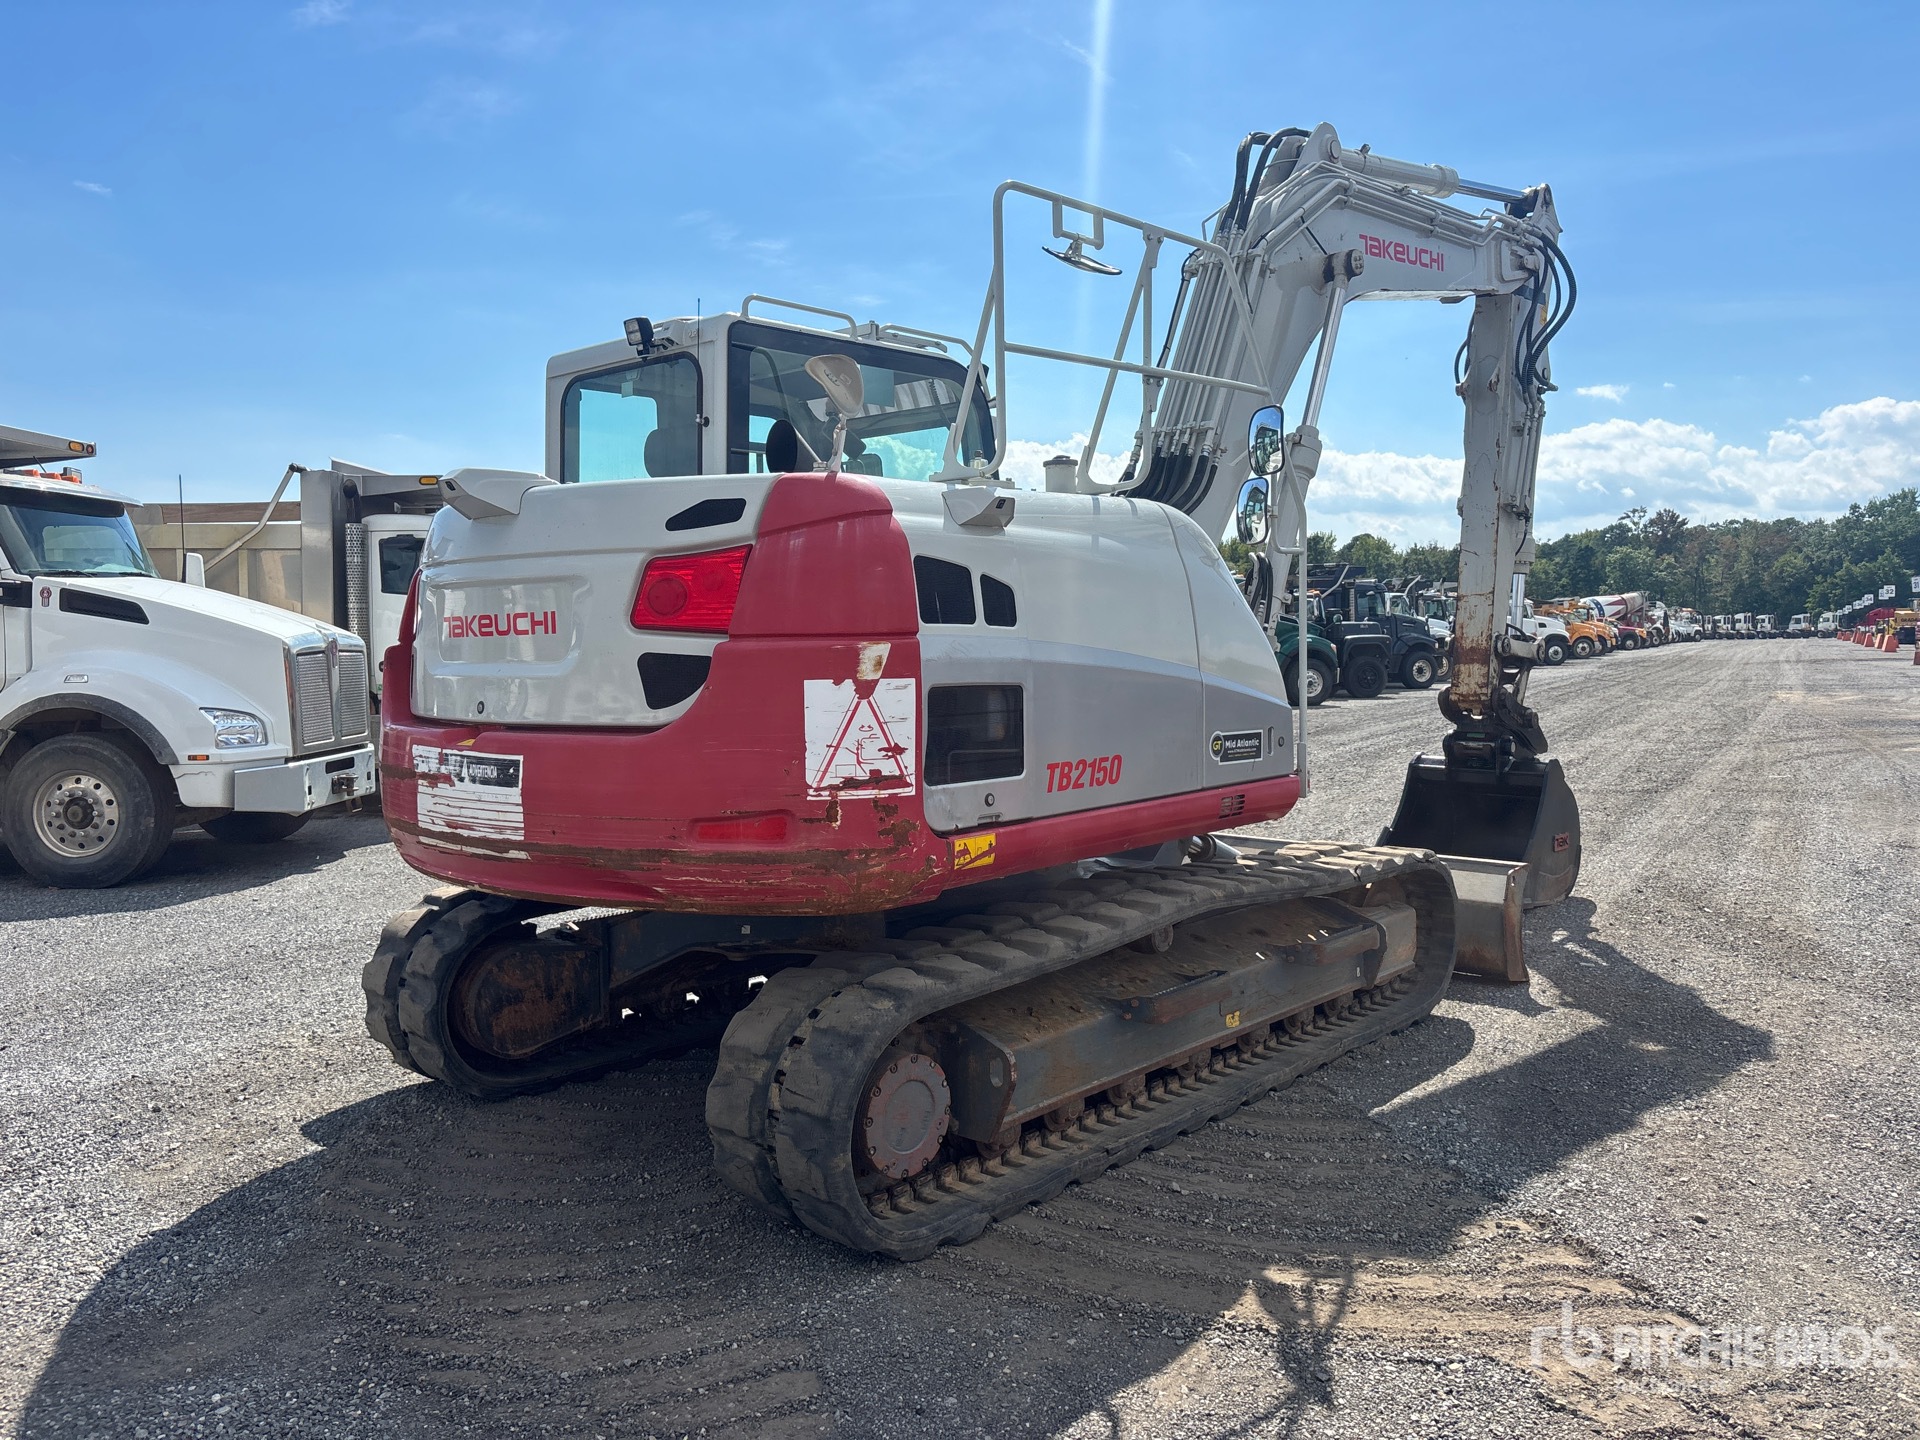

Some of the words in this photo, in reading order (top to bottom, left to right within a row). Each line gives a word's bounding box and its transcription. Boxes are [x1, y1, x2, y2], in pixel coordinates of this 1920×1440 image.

[1212, 740, 1222, 750] GT
[1225, 739, 1236, 748] Mid
[1236, 738, 1260, 748] Atlantic
[1046, 754, 1123, 794] TB2150
